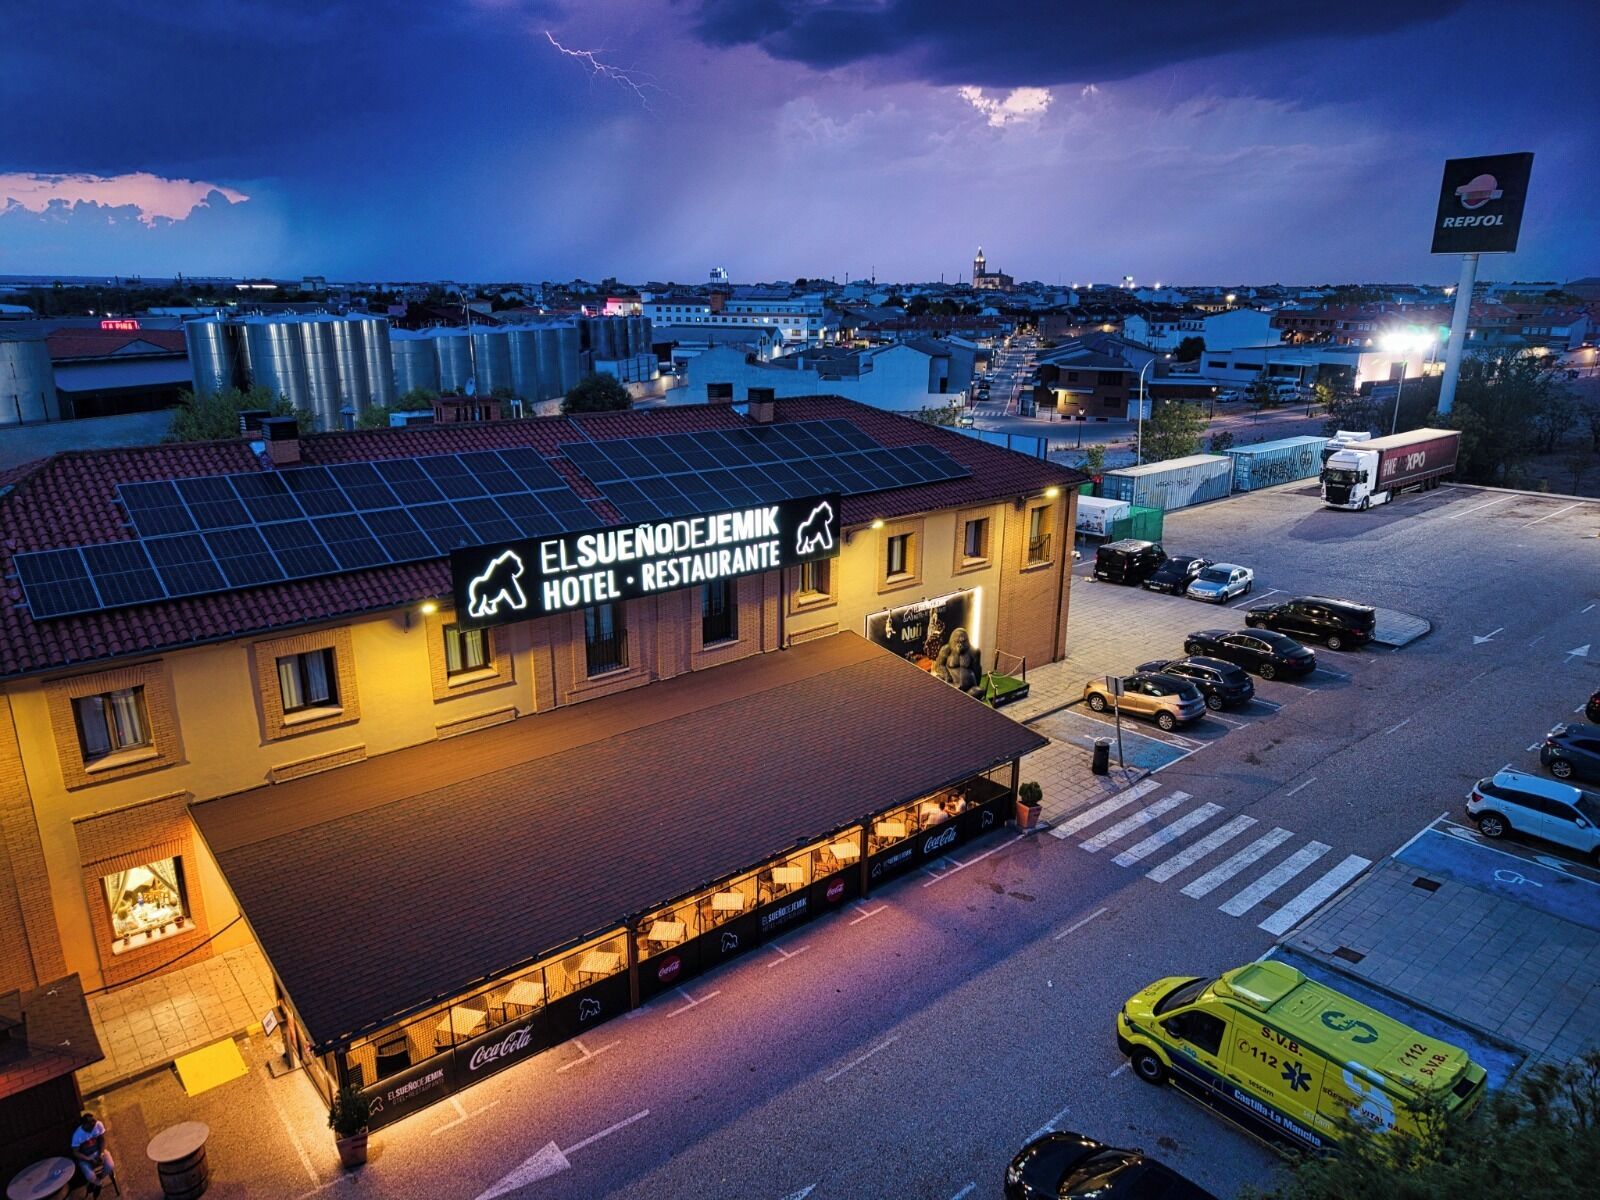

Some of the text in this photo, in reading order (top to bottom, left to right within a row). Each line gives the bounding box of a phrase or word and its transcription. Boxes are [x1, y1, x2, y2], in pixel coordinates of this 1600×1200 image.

[1442, 214, 1504, 228] REPSOL
[1405, 450, 1426, 471] XPO
[543, 540, 780, 611] HOTEL RESTAURANTE
[1261, 1027, 1303, 1057] S.V.B.
[1404, 1043, 1428, 1060] 112
[1251, 1047, 1278, 1069] 112
[1419, 1054, 1449, 1076] S.V.B.
[1248, 1079, 1275, 1097] sescam
[1234, 1089, 1321, 1148] Castilla-La Mancha
[1361, 1107, 1385, 1126] VITAL
